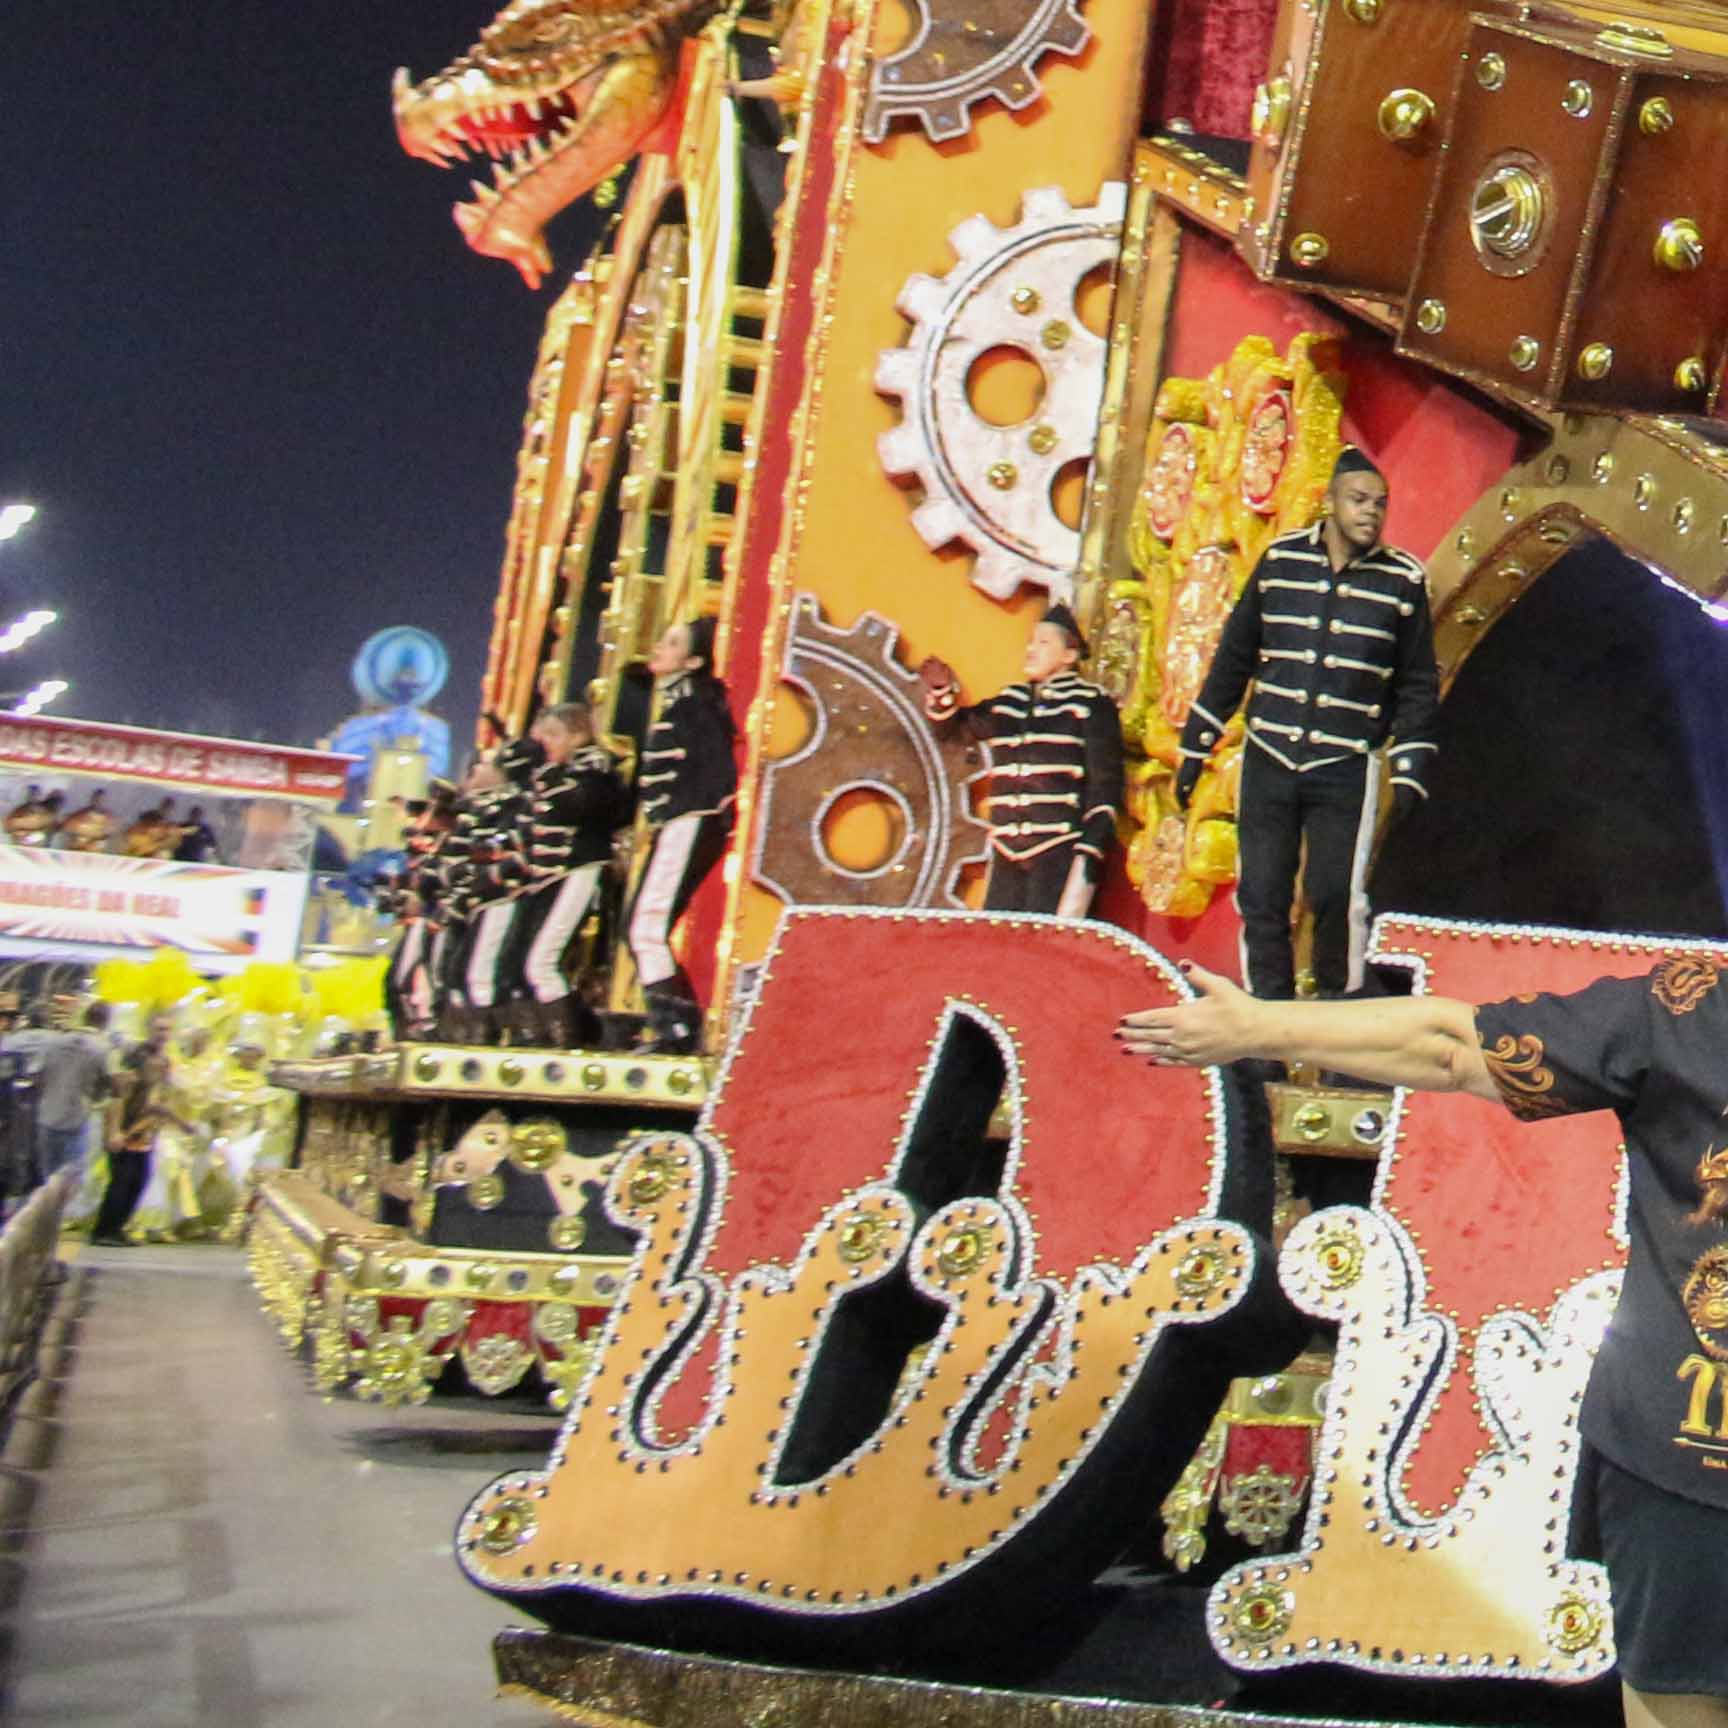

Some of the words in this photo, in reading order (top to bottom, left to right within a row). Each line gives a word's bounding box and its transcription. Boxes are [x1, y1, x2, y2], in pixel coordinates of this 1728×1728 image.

[49, 729, 164, 774] ESCOLAS
[167, 743, 204, 777] DE
[206, 750, 289, 787] SAMBA
